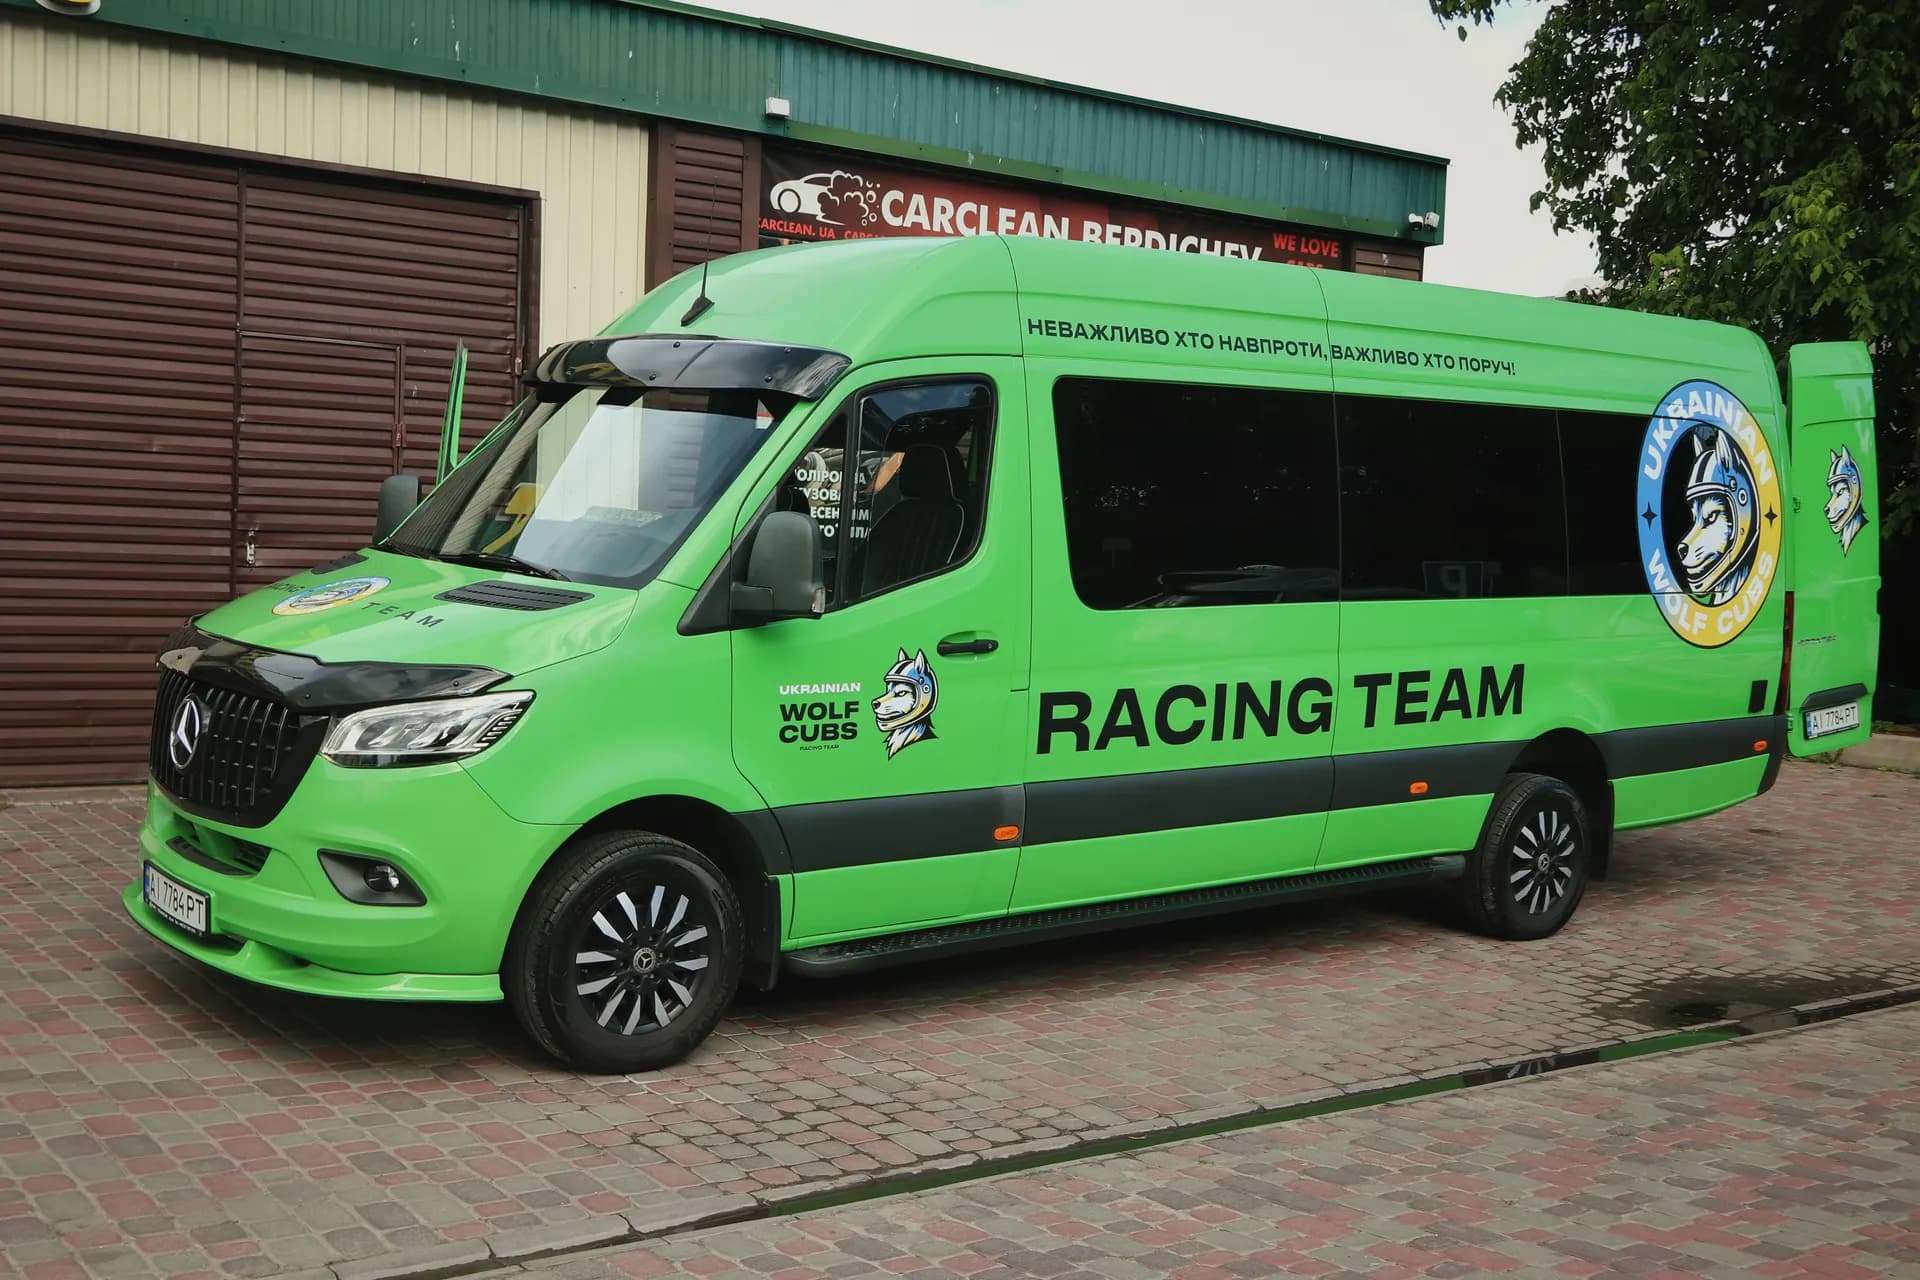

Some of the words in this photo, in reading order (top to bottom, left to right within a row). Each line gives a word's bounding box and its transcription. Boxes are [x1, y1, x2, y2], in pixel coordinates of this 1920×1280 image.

[881, 190, 1070, 240] CARCLEAN
[819, 227, 836, 239] UA
[1273, 232, 1297, 251] WE
[1300, 237, 1339, 258] LOVE
[1027, 318, 1170, 346] НЕВАЖЛИВО
[1175, 332, 1214, 350] ХТО
[1219, 334, 1328, 361] НАВПРОТИ,
[1331, 345, 1420, 368] ВАЖЛИВО
[1423, 353, 1455, 370] ХТО
[1459, 356, 1516, 376] ПОРУЧ!
[1643, 390, 1772, 484] UKRAINIAN
[1648, 548, 1708, 635] WOLF
[1717, 551, 1773, 635] CUBS
[361, 602, 445, 628] TEAM
[779, 682, 861, 695] UKRAINIAN
[779, 701, 859, 721] WOLF
[1036, 677, 1334, 755] RACING
[1353, 663, 1525, 728] TEAM
[779, 722, 858, 743] CUBS
